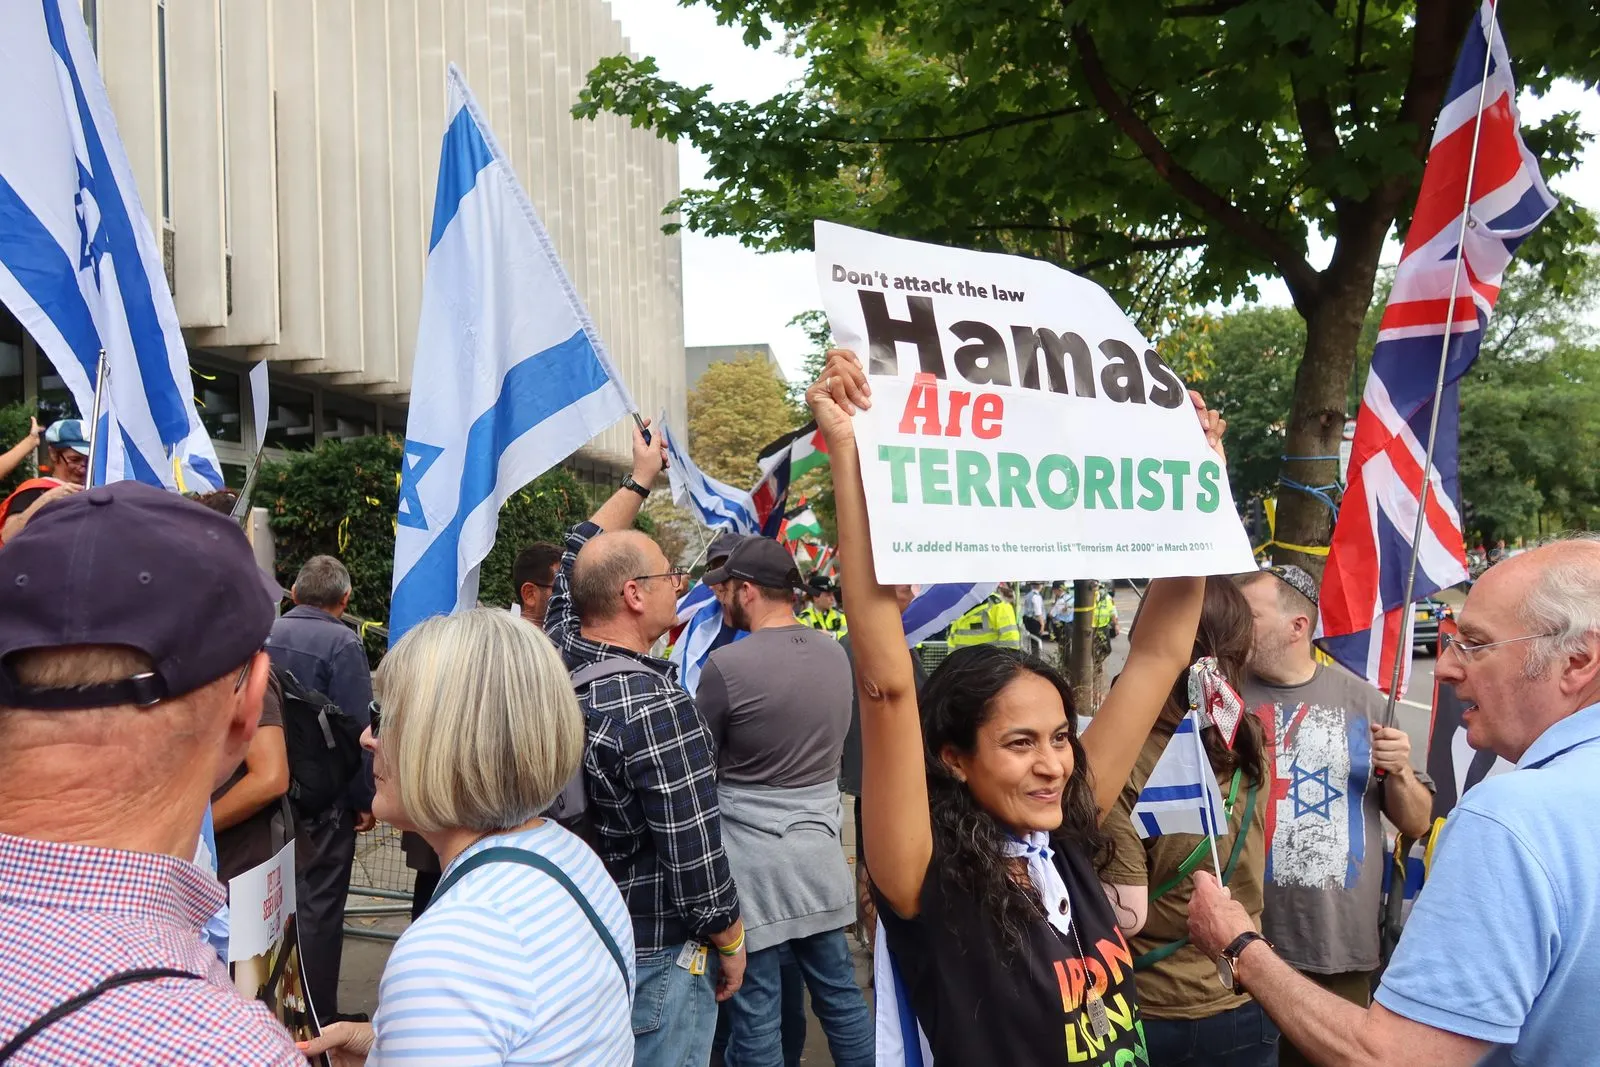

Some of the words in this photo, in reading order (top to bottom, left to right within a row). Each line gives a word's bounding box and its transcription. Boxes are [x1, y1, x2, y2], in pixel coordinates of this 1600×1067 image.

[832, 263, 889, 289] Don't
[893, 275, 953, 295] attack
[956, 280, 988, 299] the
[991, 283, 1025, 302] law
[857, 289, 1185, 410] Hamas
[898, 372, 1004, 440] Are
[877, 444, 1221, 514] TERRORISTS
[892, 541, 914, 553] U.K
[916, 540, 953, 553] added
[954, 541, 989, 553] Hamas
[990, 543, 1001, 552] to
[1001, 541, 1018, 552] the
[1019, 542, 1056, 553] terrorist
[1056, 541, 1072, 552] list
[1115, 543, 1129, 552] Act
[1130, 543, 1155, 552] 2000"
[1156, 543, 1164, 552] in
[1164, 542, 1188, 552] March
[1053, 925, 1134, 1013] IRON
